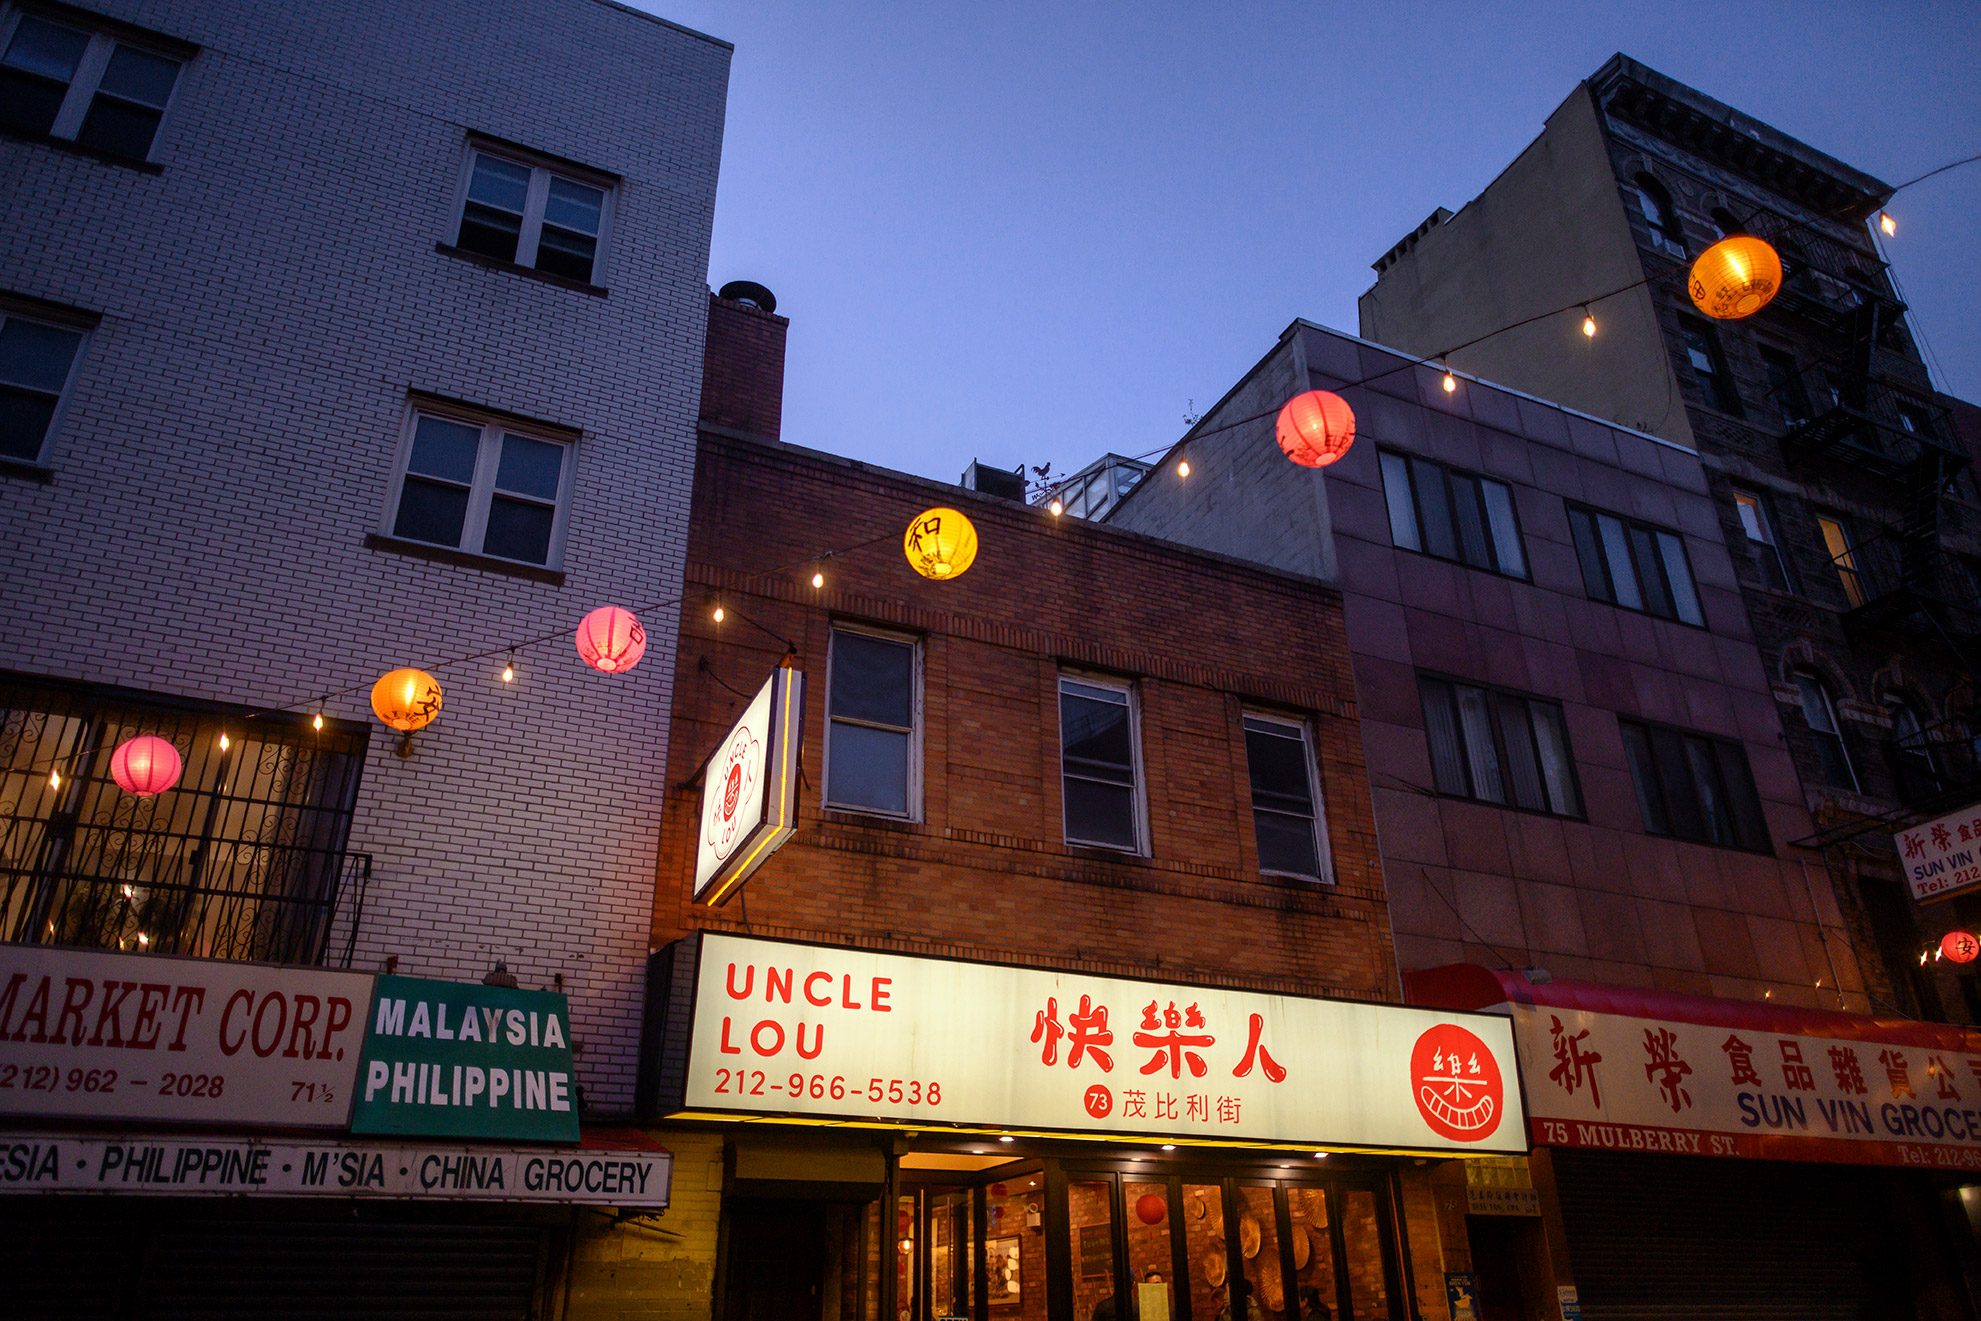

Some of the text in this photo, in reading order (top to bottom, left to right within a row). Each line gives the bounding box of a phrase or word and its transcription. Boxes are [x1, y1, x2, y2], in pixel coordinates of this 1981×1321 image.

[908, 516, 941, 552] 和
[724, 742, 747, 781] UNCLE
[721, 814, 737, 846] LOU
[1913, 850, 1974, 881] SUN VIN
[1917, 877, 1949, 895] Tel:
[1955, 937, 1976, 955] 安
[726, 962, 893, 1012] UNCLE
[219, 988, 352, 1062] CORP.
[375, 997, 567, 1049] MALAYSIA
[720, 1016, 824, 1060] LOU
[1030, 993, 1287, 1083] 快樂人
[0, 1063, 60, 1094] 212)
[66, 1068, 118, 1094] 962
[159, 1072, 225, 1099] 2028
[364, 1060, 571, 1112] PHILIPPINE
[714, 1068, 941, 1106] 212-966-5538
[1089, 1089, 1242, 1124] 73 茂比利街
[1737, 1091, 1981, 1142] SUN VIN GROCE
[1544, 1121, 1740, 1156] 75 MULBERRY ST.
[1897, 1145, 1931, 1165] Tel:
[98, 1145, 272, 1185] PHILIPPINE
[301, 1150, 385, 1187] M'SIA
[420, 1154, 505, 1190] CHINA
[524, 1158, 653, 1194] GROCERY
